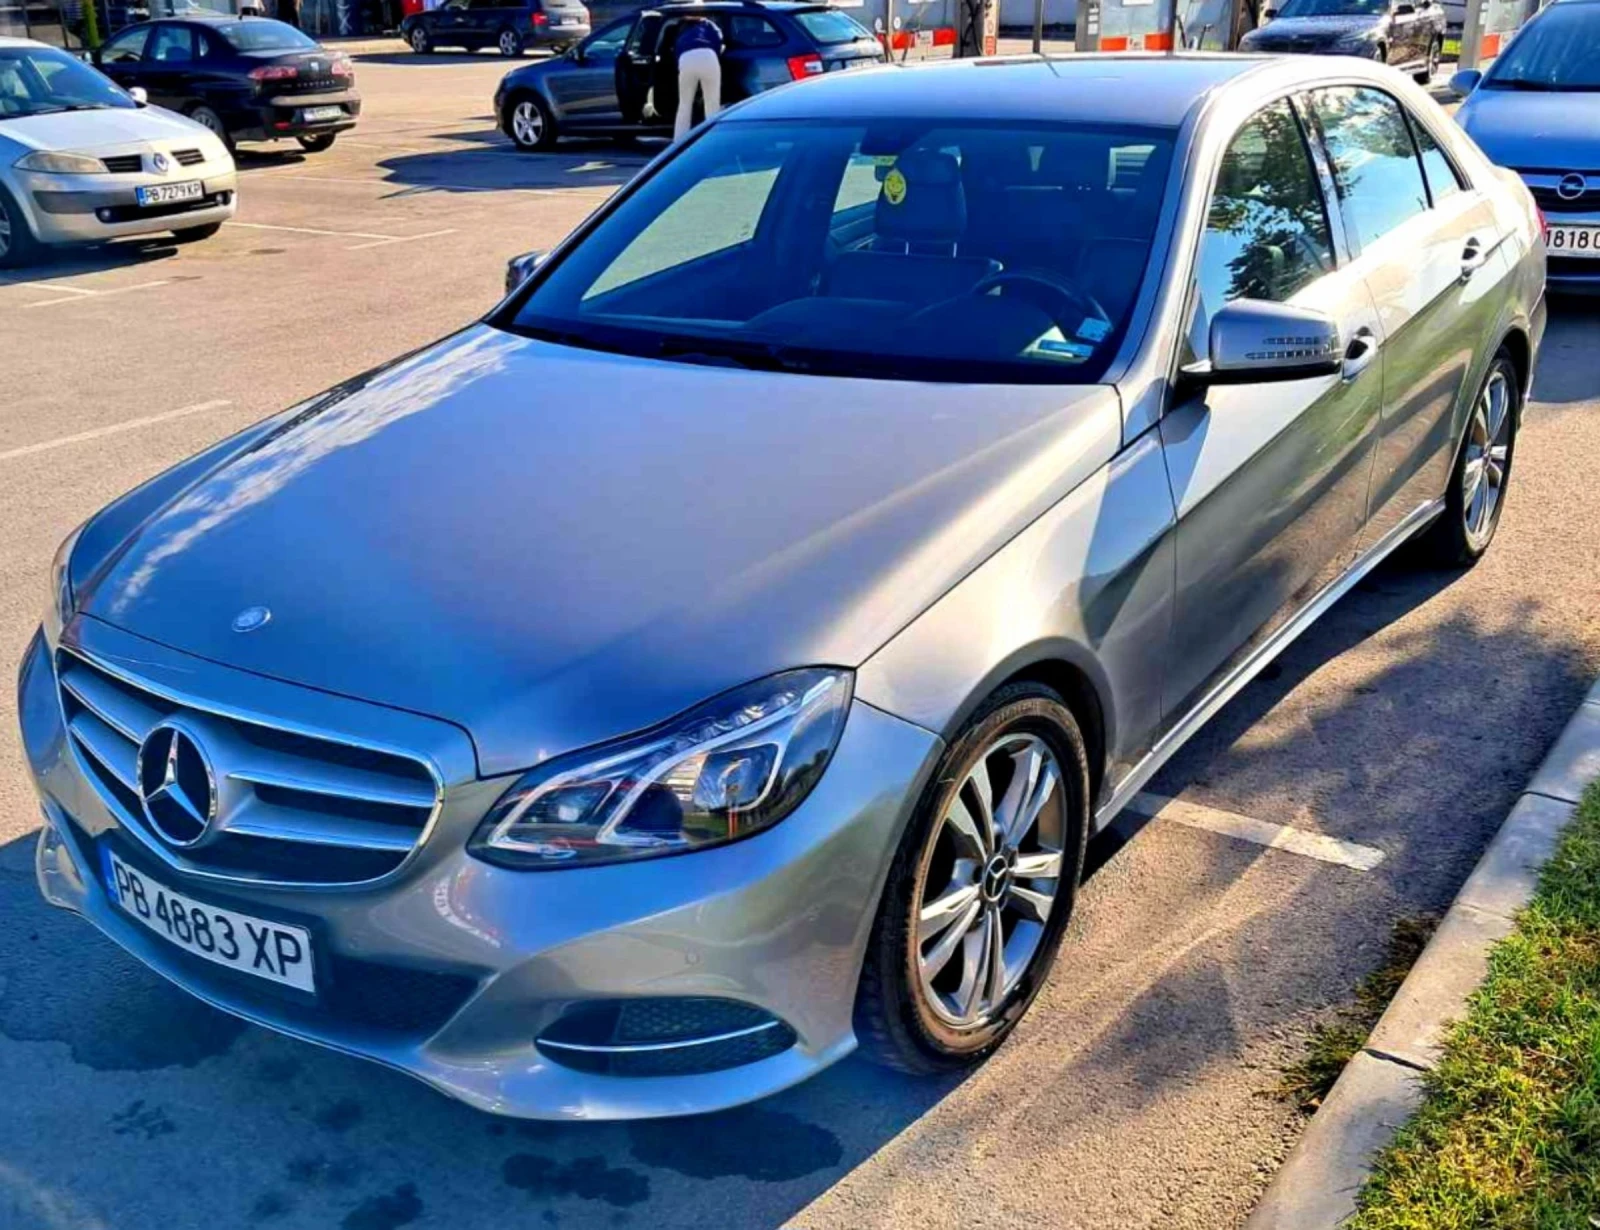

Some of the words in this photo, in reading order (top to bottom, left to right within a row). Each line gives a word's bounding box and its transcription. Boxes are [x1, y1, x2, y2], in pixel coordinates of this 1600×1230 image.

[145, 188, 159, 201] PB
[161, 185, 185, 200] 7279
[186, 183, 200, 196] KP
[113, 860, 151, 918] PB
[155, 890, 240, 960] 4883
[245, 922, 301, 976] XP
